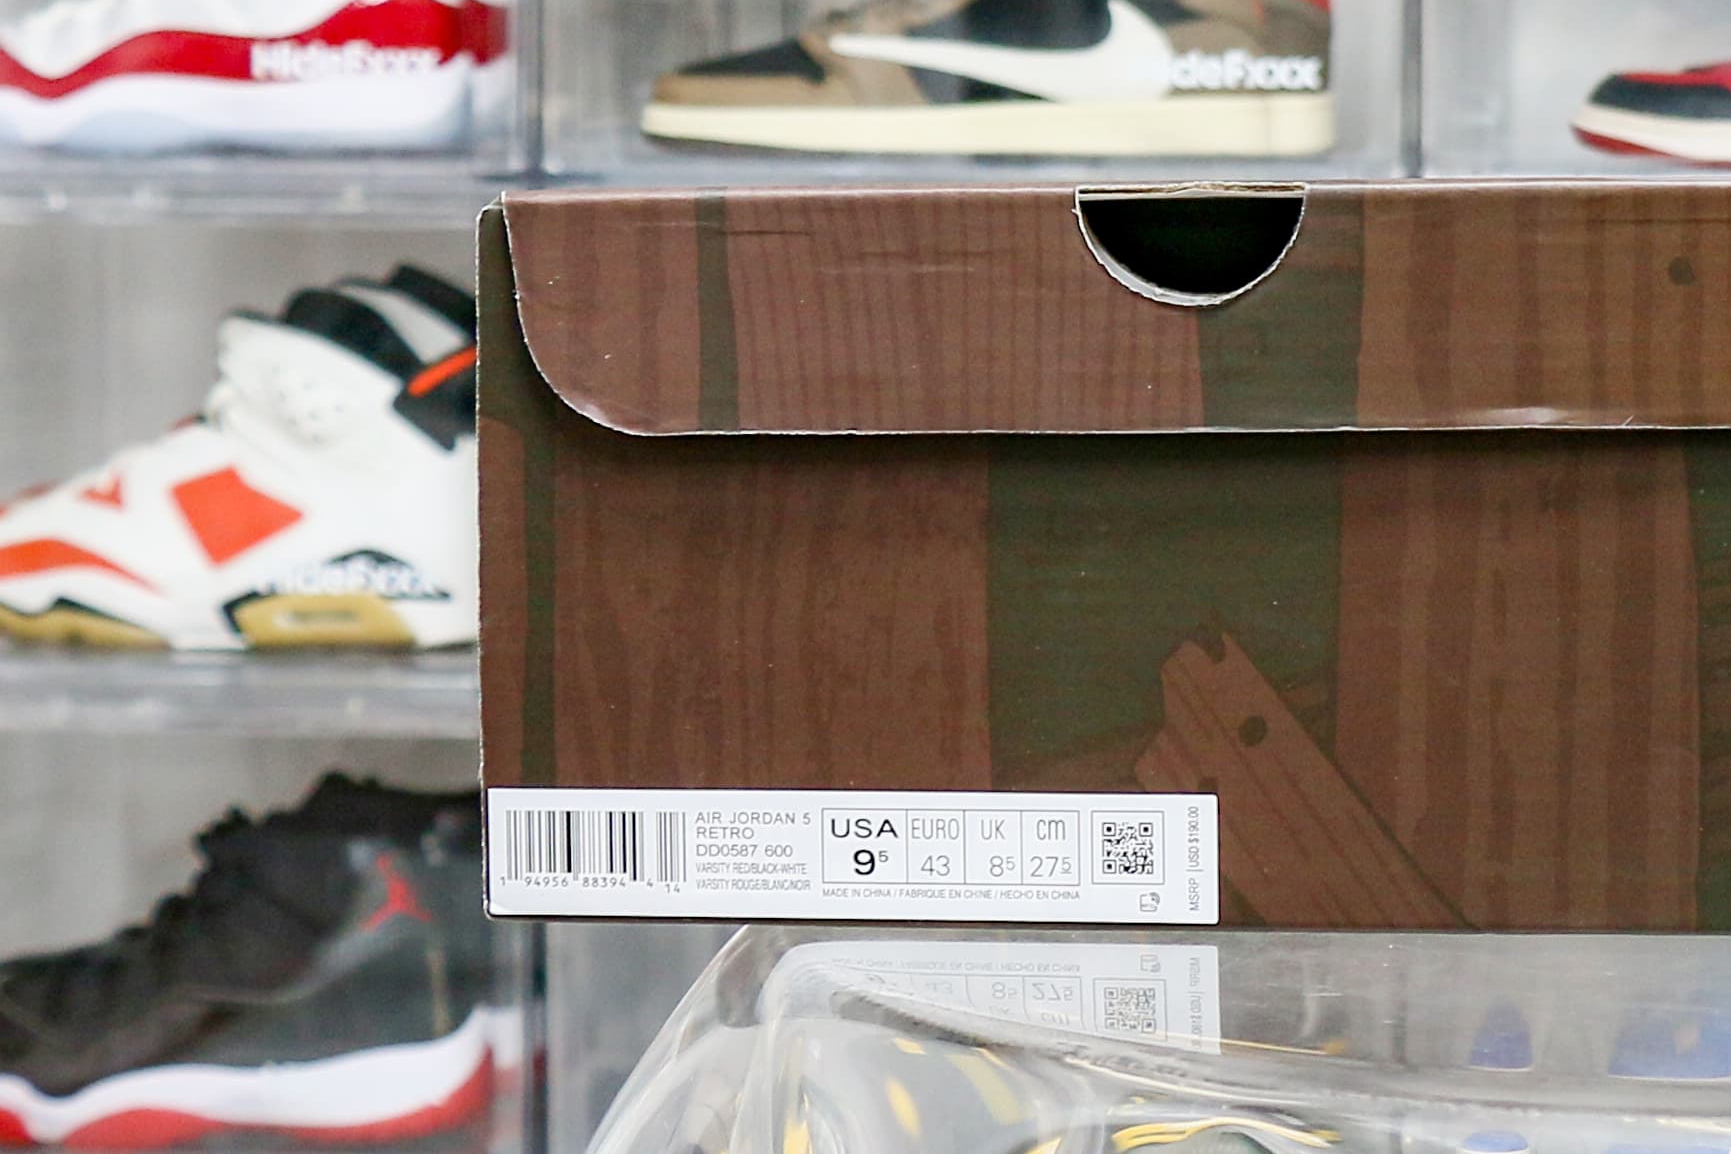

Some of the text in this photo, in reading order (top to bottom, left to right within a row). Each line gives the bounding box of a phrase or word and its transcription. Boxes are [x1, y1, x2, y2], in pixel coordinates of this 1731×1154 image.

[695, 811, 811, 825] AIR JORDAN 5
[696, 826, 755, 839] RETRO
[830, 818, 899, 839] USA
[911, 818, 960, 840] EURO
[980, 819, 1006, 840] UK
[696, 844, 793, 857] DD0587 600
[1188, 846, 1200, 867] USD
[921, 855, 950, 876] 43
[524, 876, 568, 887] 94956
[582, 878, 626, 888] 88394
[646, 878, 653, 887] 4
[666, 883, 680, 893] 14
[822, 888, 849, 898] MADE
[851, 888, 860, 898] IN
[862, 888, 891, 898] CHINA
[899, 889, 946, 899] FABRIQUE
[948, 889, 961, 899] EN
[1000, 890, 1033, 900] HECHO
[1036, 890, 1049, 900] EN
[1051, 890, 1080, 900] CHINA
[1188, 877, 1200, 911] MSRP
